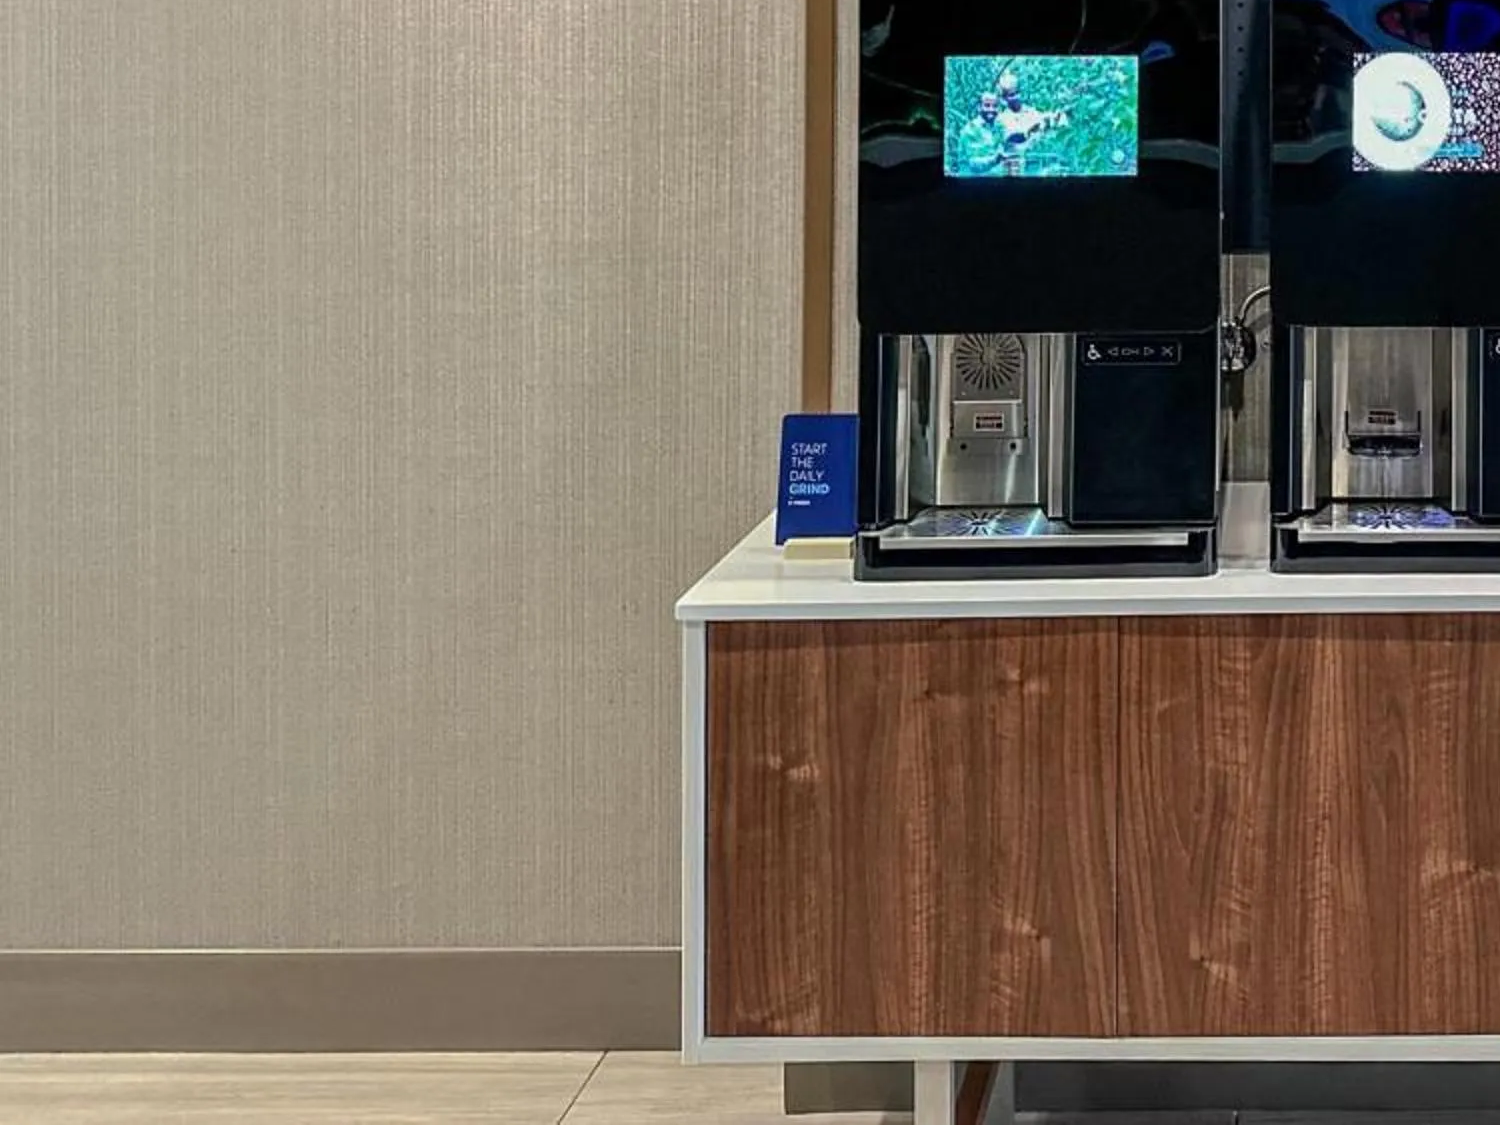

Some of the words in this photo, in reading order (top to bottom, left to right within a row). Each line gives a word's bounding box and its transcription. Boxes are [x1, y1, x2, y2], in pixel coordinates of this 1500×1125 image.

[791, 442, 828, 456] START
[791, 456, 815, 469] THE
[789, 469, 826, 482] DAILY
[789, 482, 831, 496] GRIND
